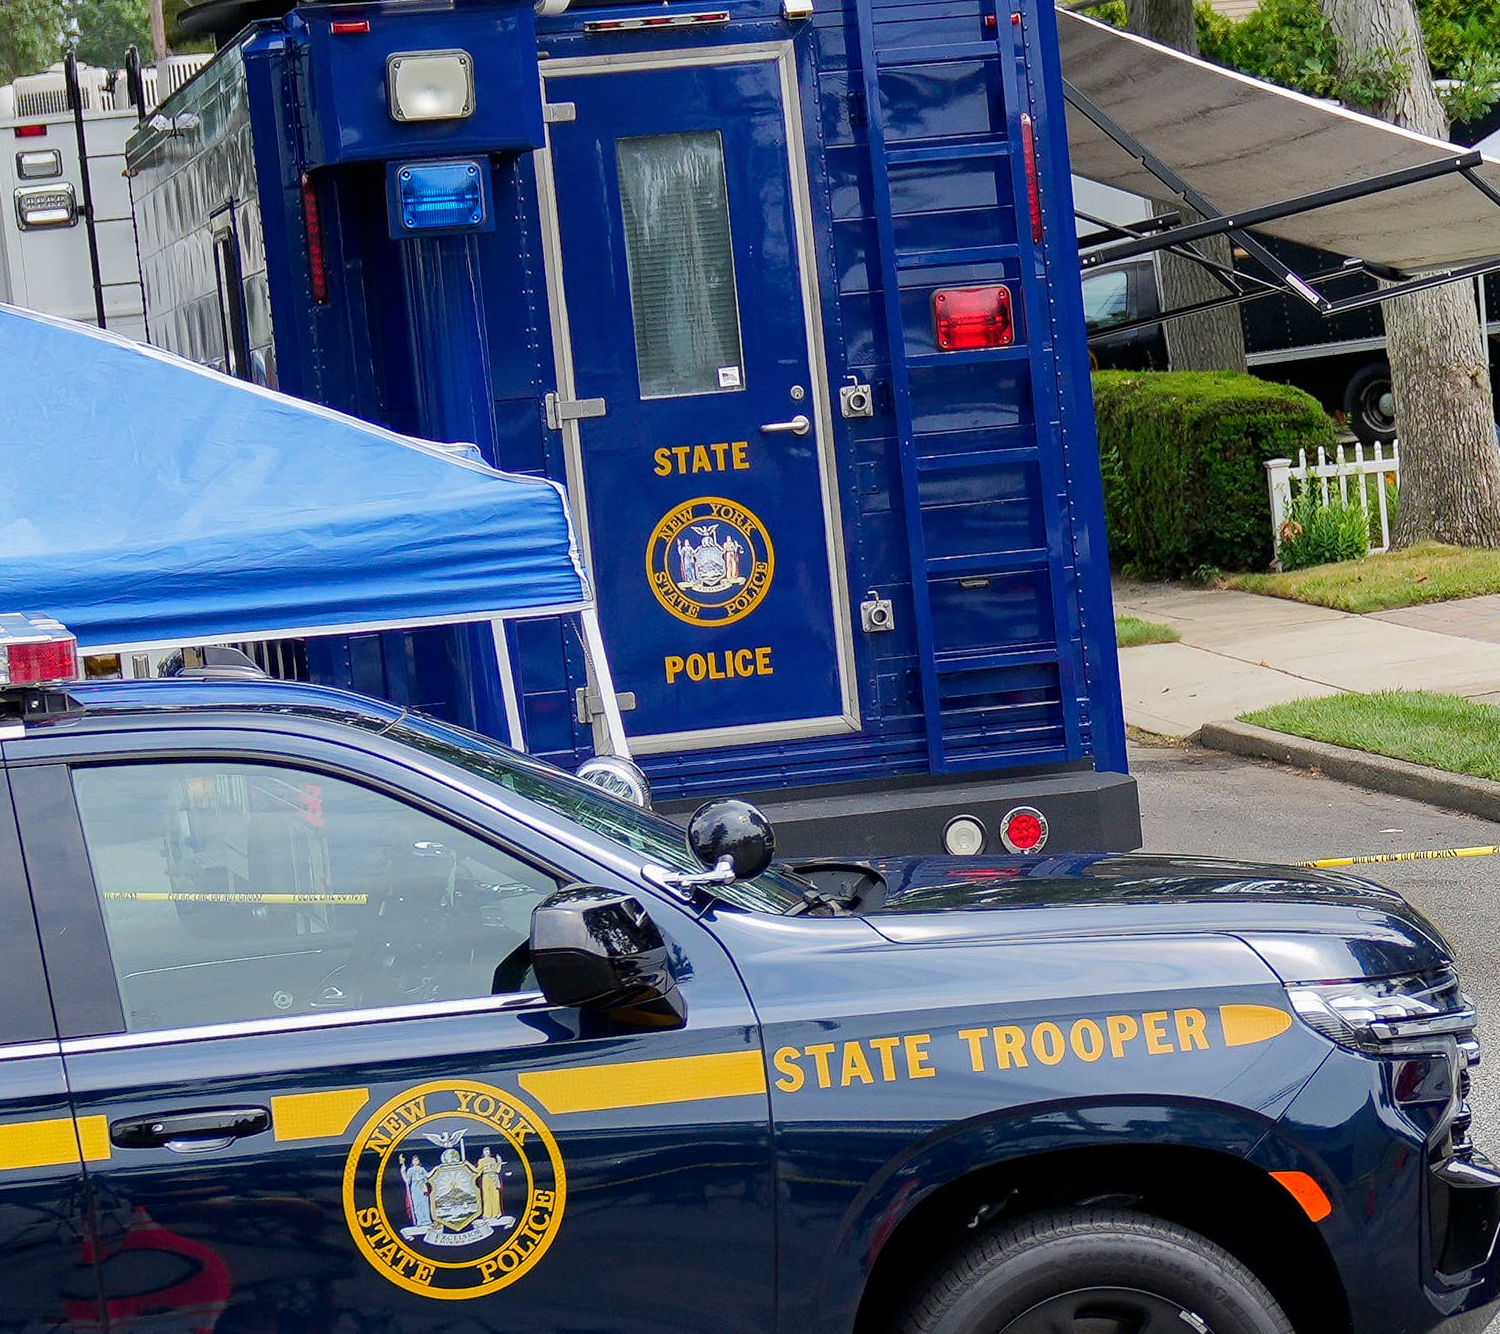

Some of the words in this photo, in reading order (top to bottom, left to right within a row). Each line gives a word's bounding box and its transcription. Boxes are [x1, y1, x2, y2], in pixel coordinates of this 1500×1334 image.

[653, 440, 751, 476] STATE
[659, 507, 694, 543] NEW
[709, 503, 757, 537] YORK
[654, 572, 700, 618] STATE
[724, 561, 768, 617] POLICE
[665, 647, 774, 684] POLICE
[773, 1033, 936, 1094] STATE
[958, 1006, 1210, 1072] TROOPER
[365, 1095, 428, 1158] NEW
[453, 1090, 537, 1147] YORK
[356, 1207, 436, 1287] STATE
[476, 1189, 556, 1285] POLICE
